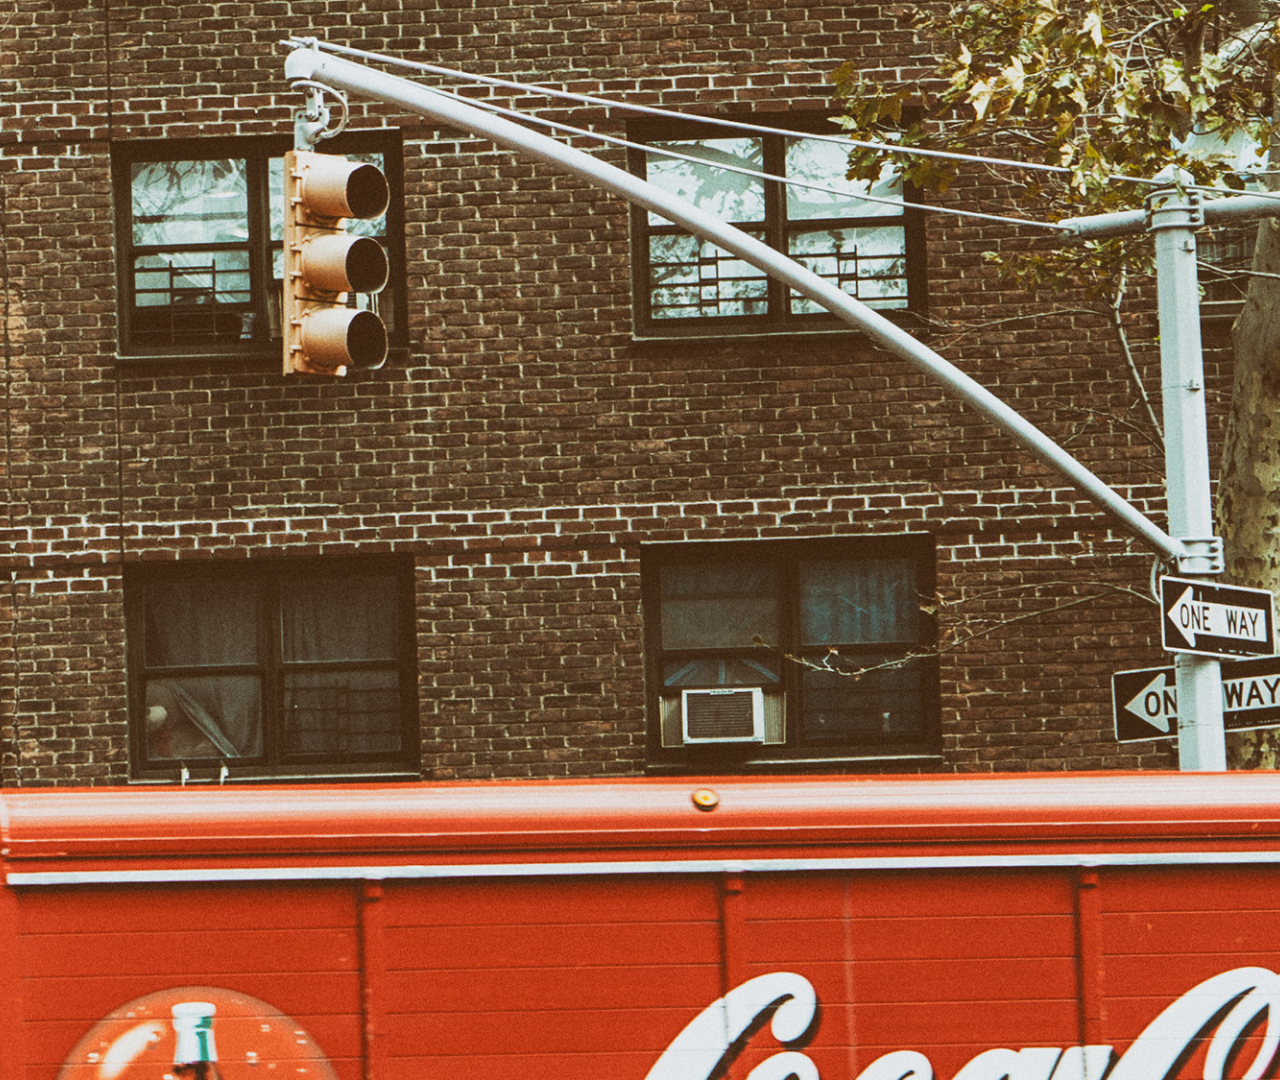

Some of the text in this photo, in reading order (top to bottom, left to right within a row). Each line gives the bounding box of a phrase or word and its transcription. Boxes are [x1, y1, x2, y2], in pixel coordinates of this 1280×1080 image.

[1180, 603, 1258, 638] ONE WAY
[1144, 687, 1177, 718] ON
